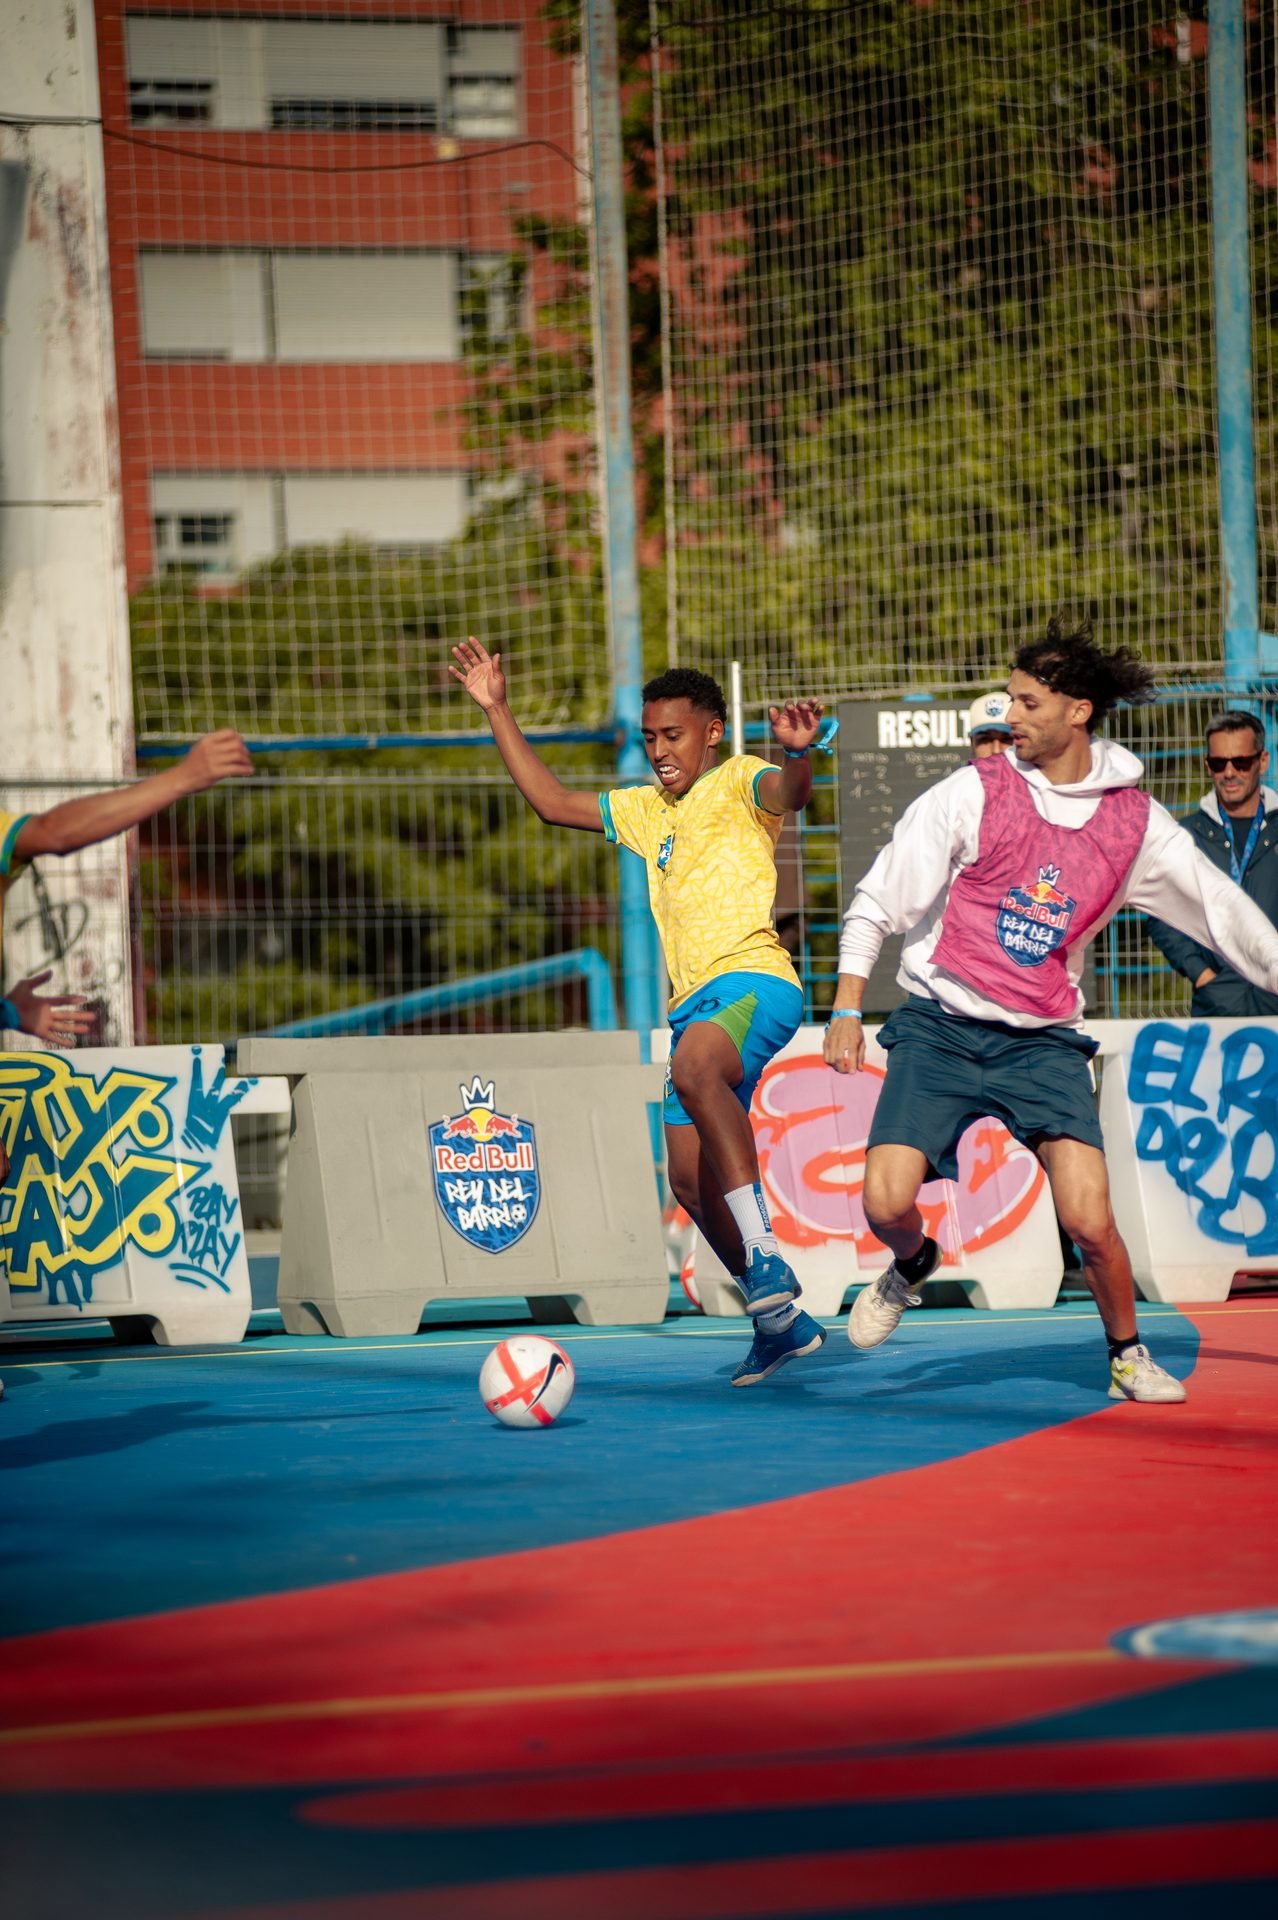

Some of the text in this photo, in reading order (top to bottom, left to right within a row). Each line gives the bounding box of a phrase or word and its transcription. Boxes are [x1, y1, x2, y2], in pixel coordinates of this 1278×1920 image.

[1003, 898, 1070, 929] Red Bull
[1002, 914, 1057, 945] REY DEL
[436, 1144, 533, 1171] Red Bull
[444, 1176, 533, 1206] REY DEL
